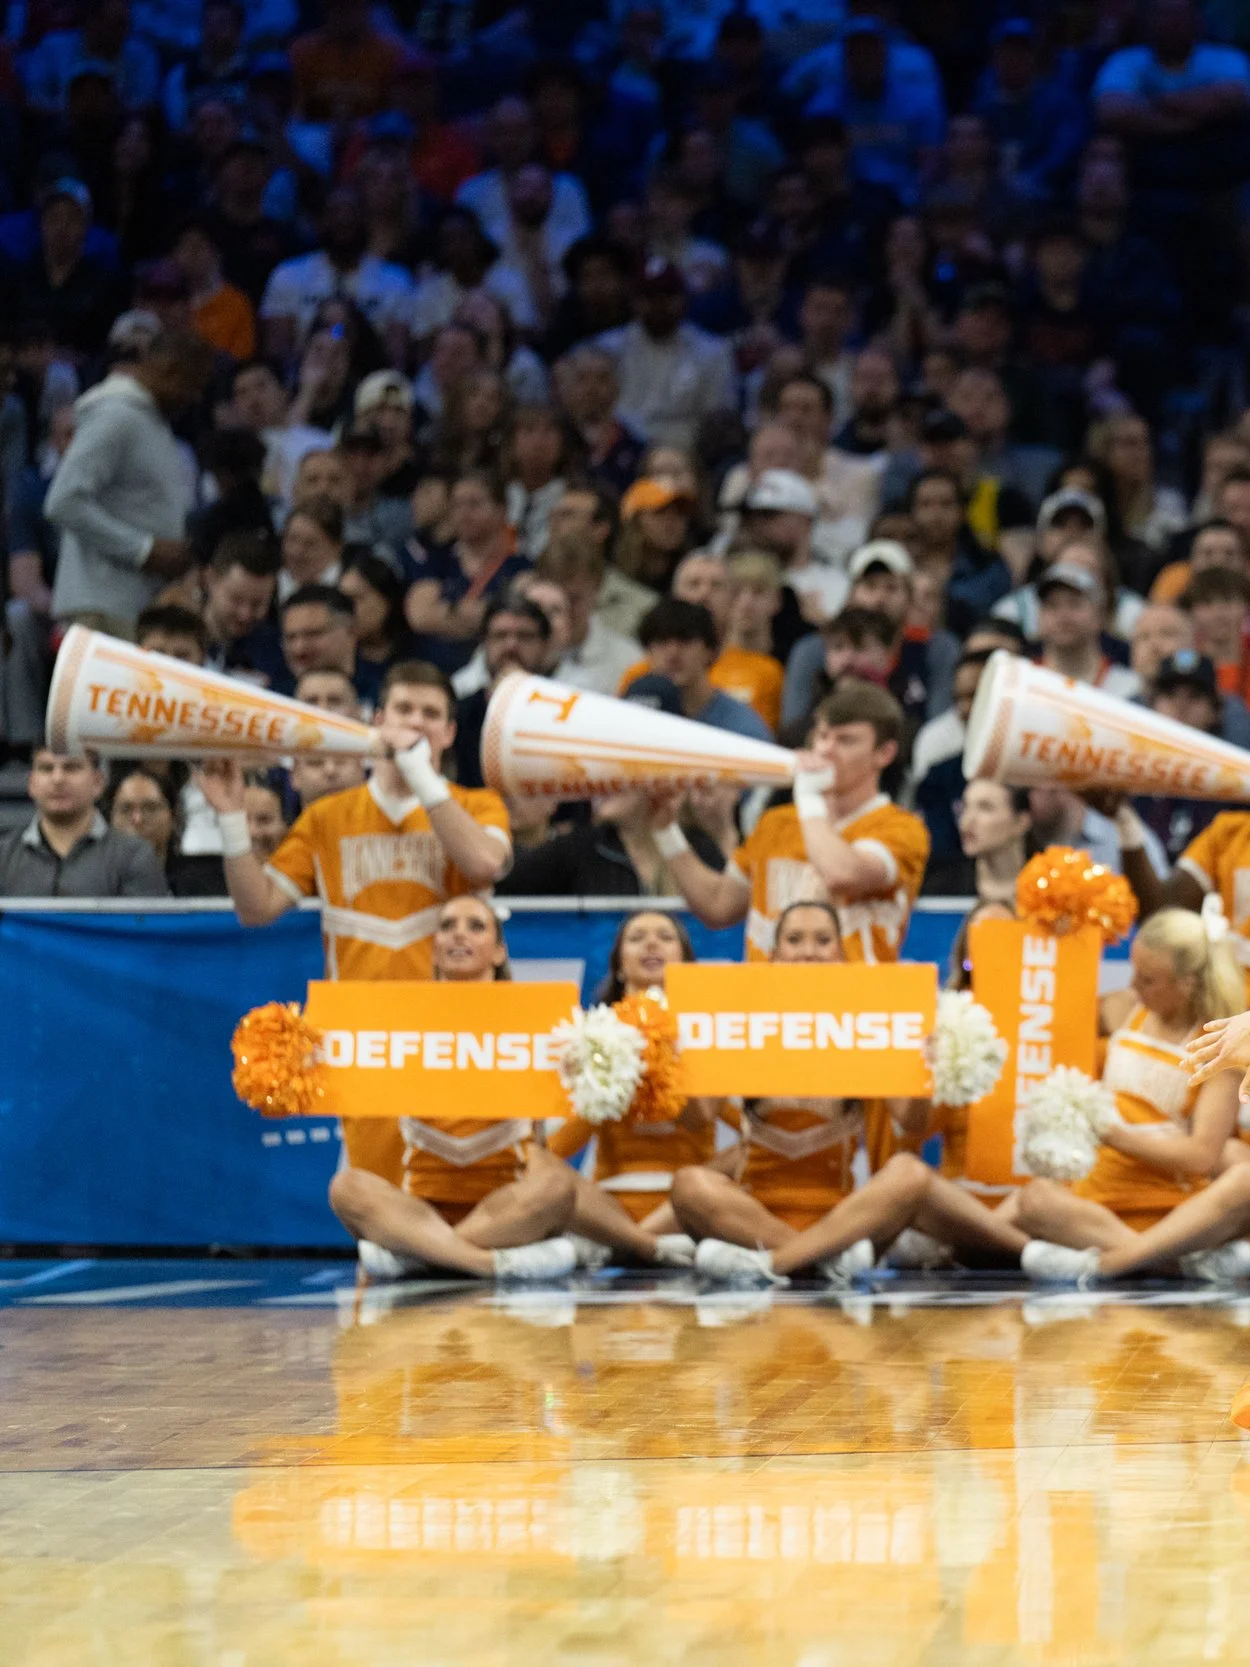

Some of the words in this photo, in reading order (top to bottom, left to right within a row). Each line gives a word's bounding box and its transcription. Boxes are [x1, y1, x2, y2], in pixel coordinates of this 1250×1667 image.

[89, 683, 288, 741] TENNESSEE
[1020, 731, 1210, 790] TENNESSEE
[323, 1030, 564, 1071] DEFENSE
[676, 1012, 925, 1050] DEFENSE
[1013, 935, 1057, 1176] FENSE
